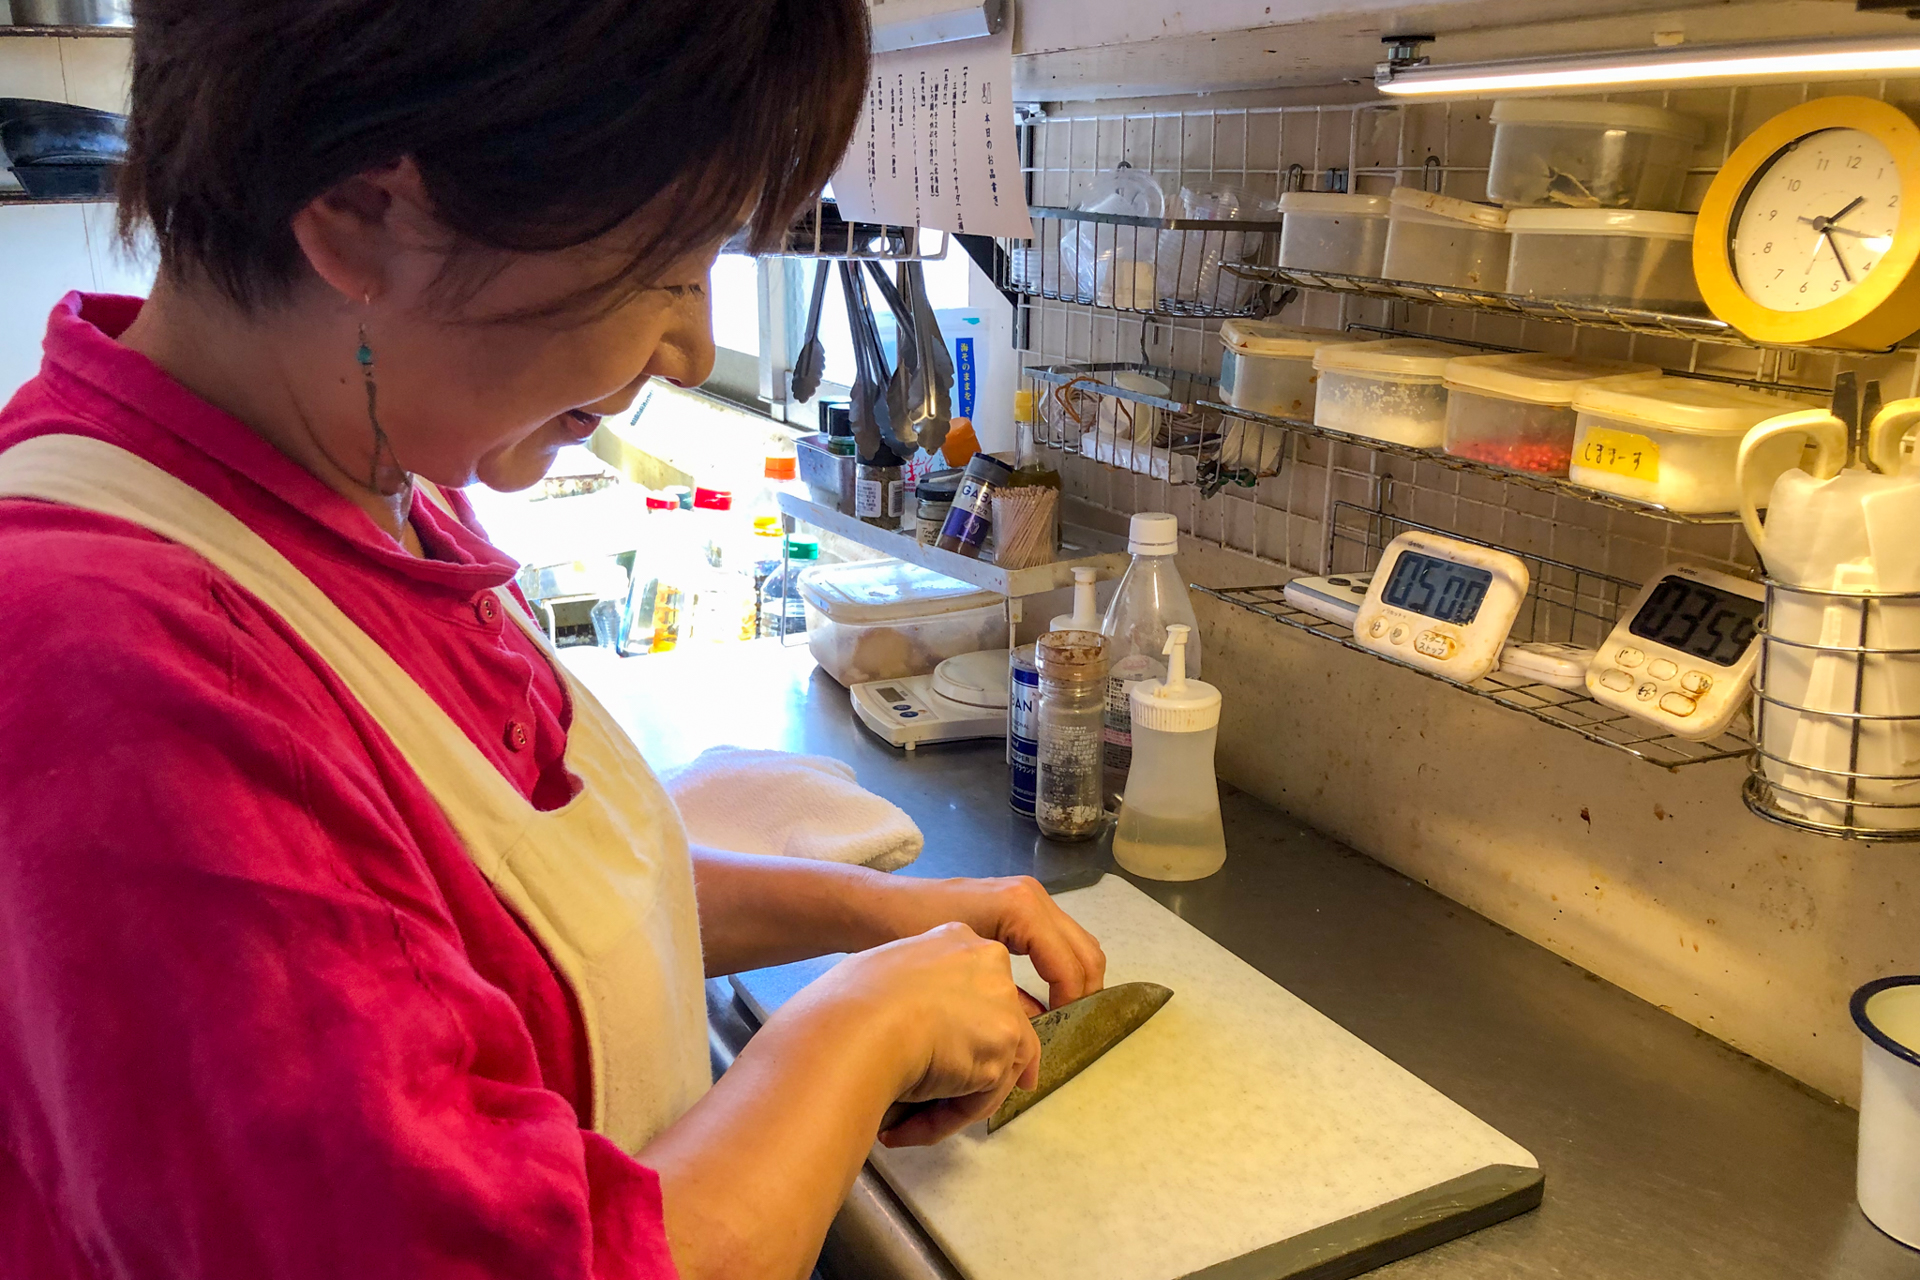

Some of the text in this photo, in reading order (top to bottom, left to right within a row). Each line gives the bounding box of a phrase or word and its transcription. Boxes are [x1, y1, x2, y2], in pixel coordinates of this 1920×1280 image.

[983, 113, 999, 207] 本日のお品書き
[1817, 158, 1830, 171] 11
[1846, 155, 1862, 169] 12
[1877, 168, 1884, 180] 1
[1786, 179, 1802, 192] 10
[1888, 195, 1898, 208] 2
[1770, 209, 1778, 222] 9
[1763, 241, 1774, 254] 8
[1862, 261, 1872, 272] 4
[1774, 268, 1784, 281] 7
[1800, 281, 1808, 293] 6
[1830, 280, 1840, 292] 5
[960, 343, 972, 419] 海そのままを、そ
[962, 484, 992, 506] GABA
[1422, 634, 1447, 646] スタート
[1419, 642, 1446, 655] ストップ
